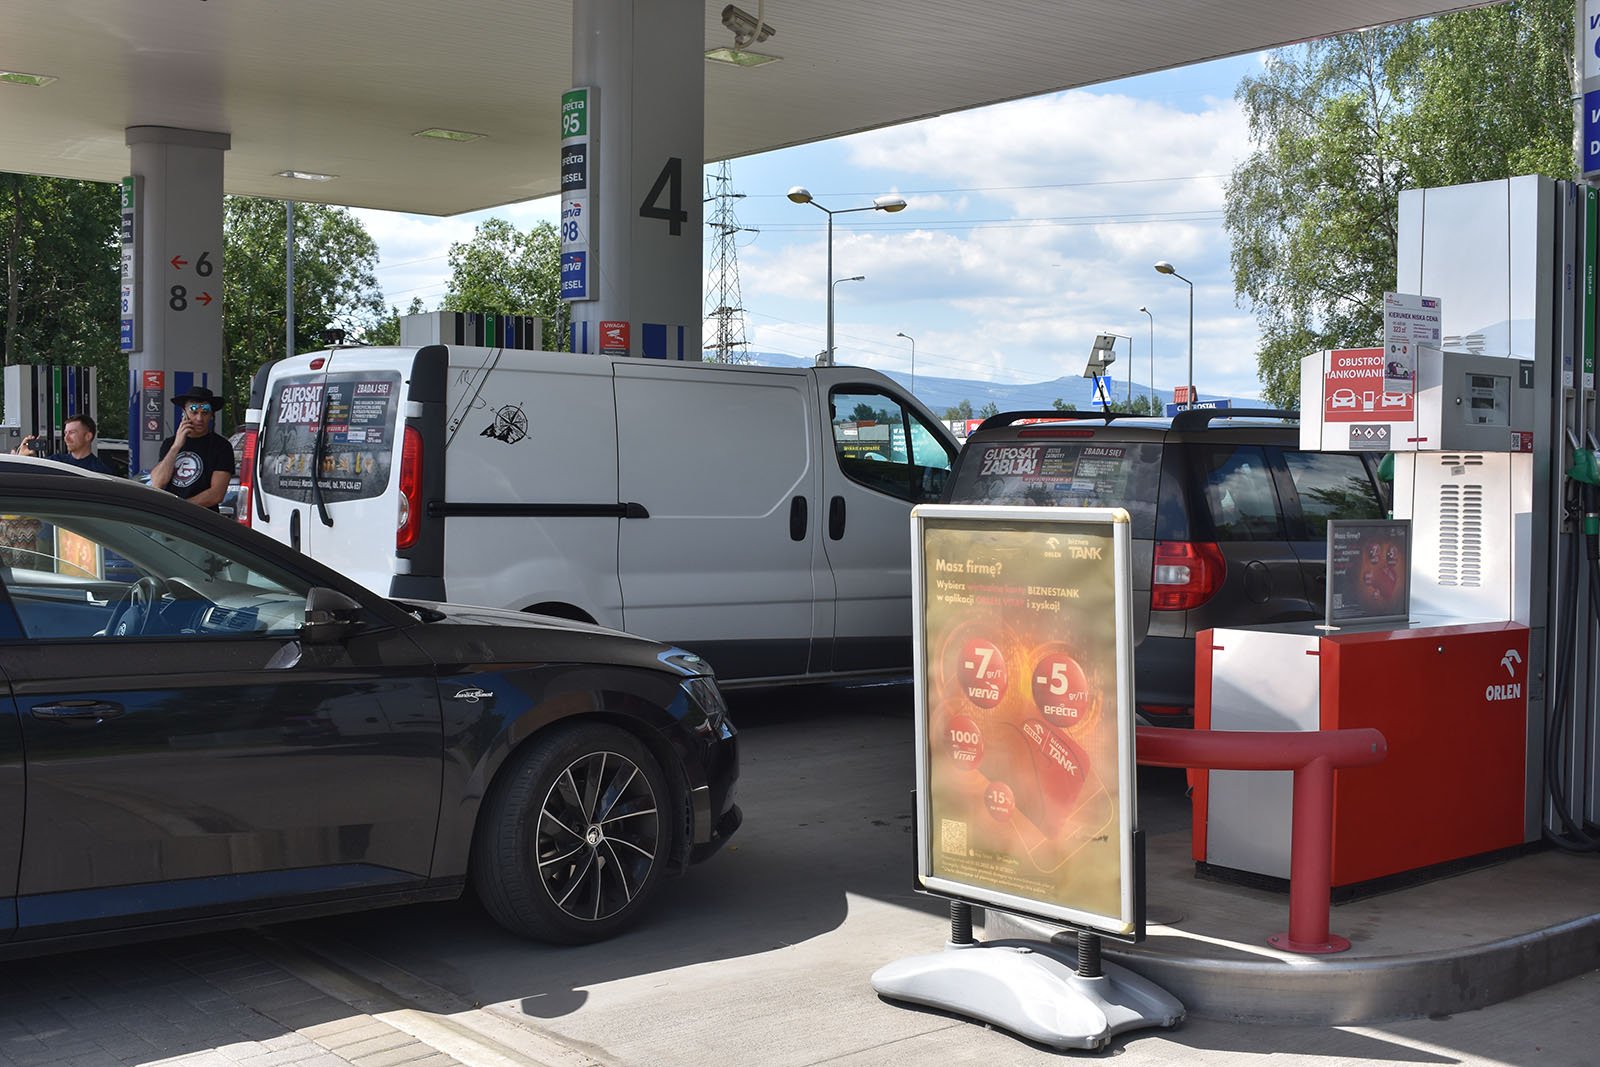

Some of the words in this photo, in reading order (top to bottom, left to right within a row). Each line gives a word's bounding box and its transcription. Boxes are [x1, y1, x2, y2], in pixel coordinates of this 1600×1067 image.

[563, 113, 580, 134] 95
[640, 158, 688, 236] 4
[563, 221, 578, 242] 98
[195, 252, 214, 278] 6
[169, 285, 188, 312] 8
[1524, 370, 1529, 385] 1
[281, 386, 322, 403] GLIFOSAT
[278, 402, 320, 423] ZABIJA!
[984, 447, 1040, 460] GLIFOSAT
[981, 459, 1038, 475] ZABIJA!
[1069, 547, 1102, 560] TANK
[936, 559, 964, 572] Masz
[966, 560, 1002, 577] firmę?
[936, 580, 966, 592] Wybierz
[1028, 586, 1080, 598] BIZNESTANK
[945, 594, 974, 605] aplikacji
[1032, 600, 1060, 612] zyskaj!
[964, 648, 994, 679] -7
[1036, 662, 1068, 695] -5
[968, 686, 1000, 700] verva
[1486, 684, 1520, 701] ORLEN
[950, 730, 978, 744] 1000
[1049, 743, 1077, 776] TANK
